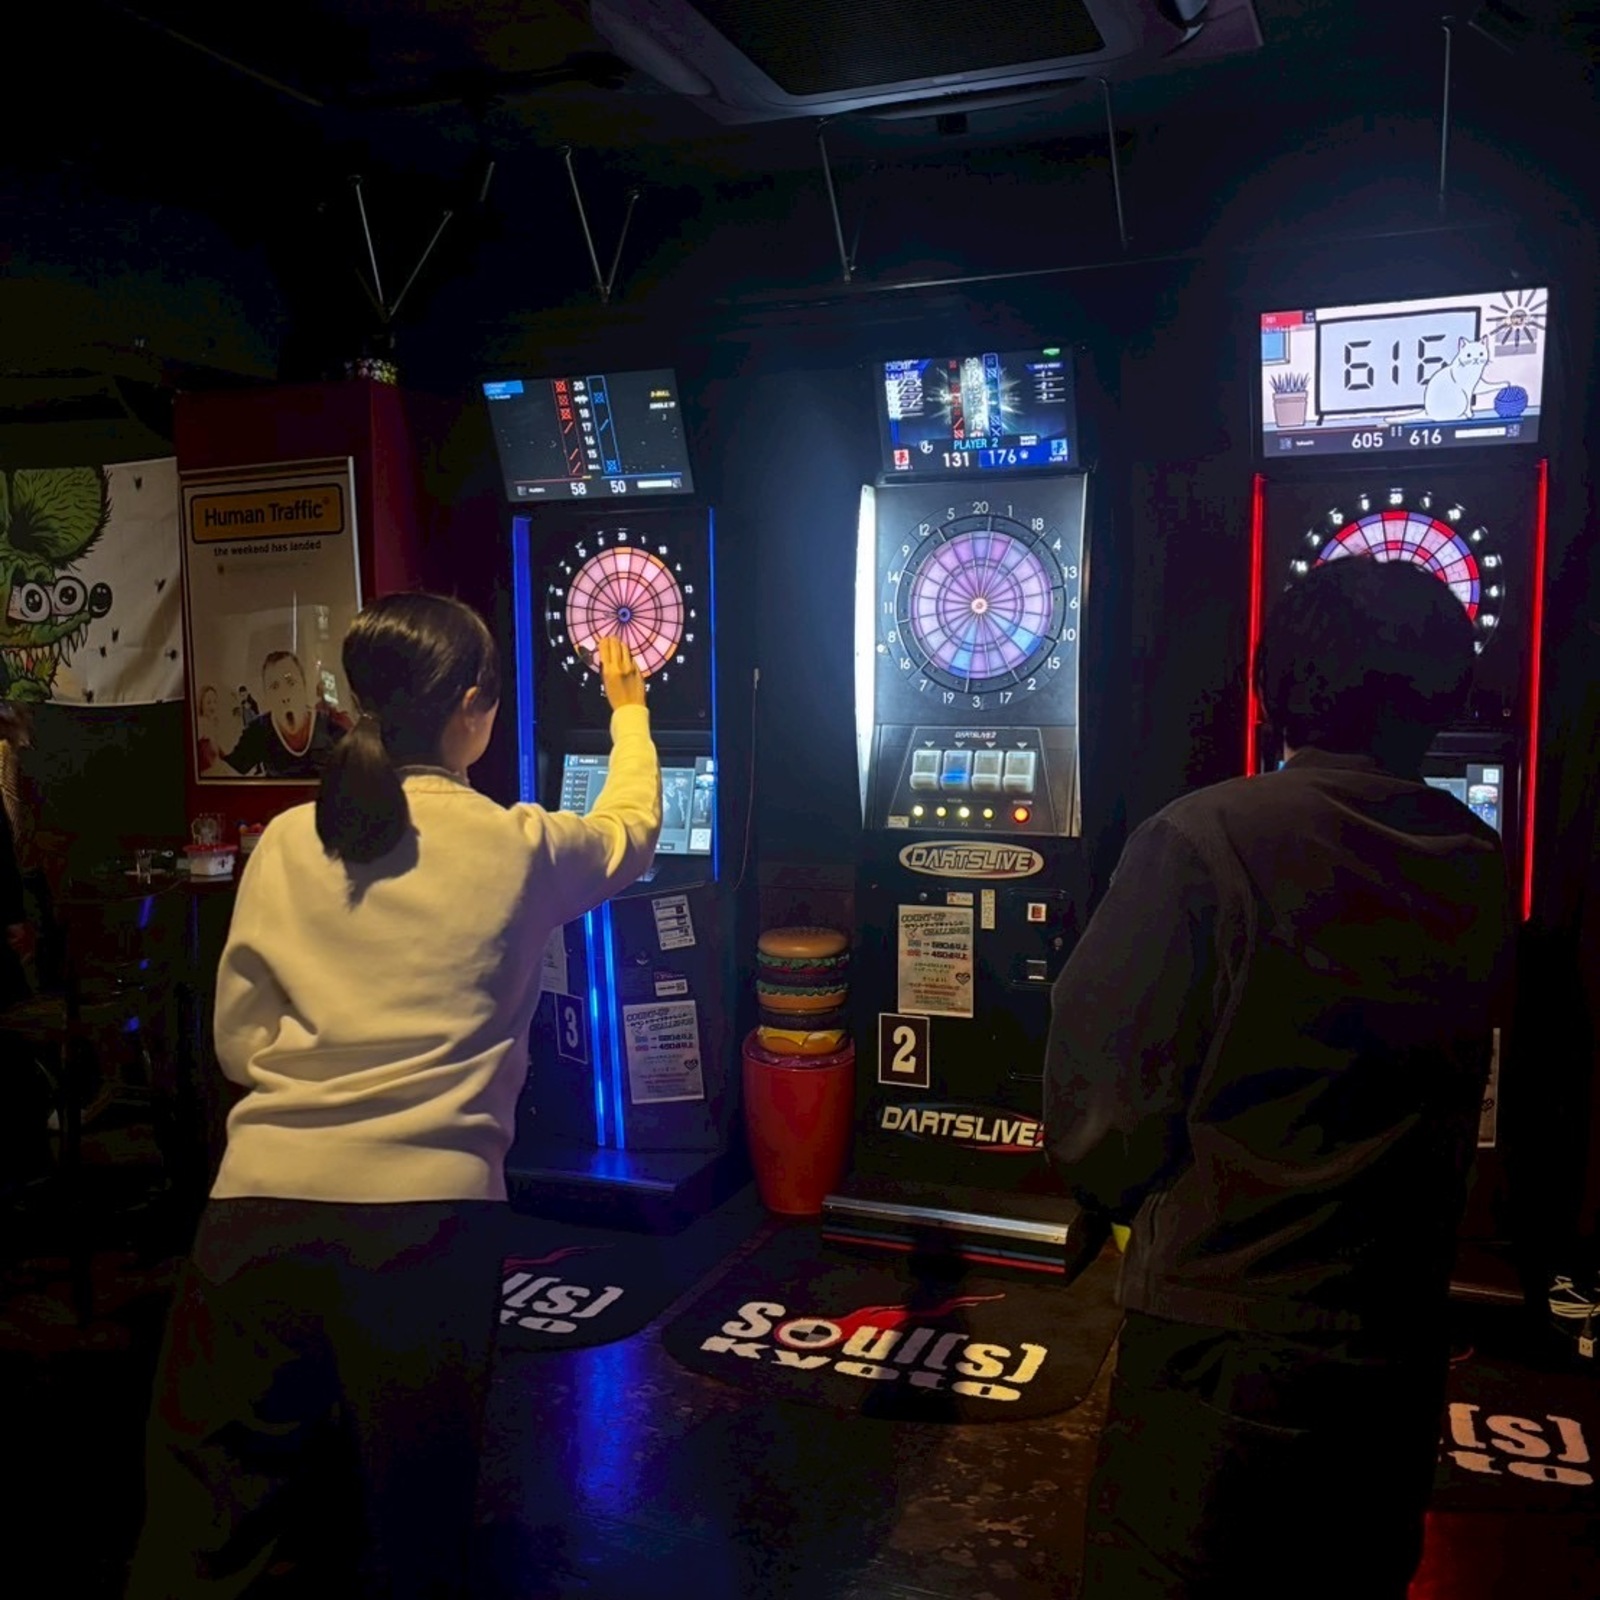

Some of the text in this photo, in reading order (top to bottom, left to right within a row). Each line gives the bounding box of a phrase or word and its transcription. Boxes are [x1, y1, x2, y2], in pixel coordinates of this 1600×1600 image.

[573, 380, 585, 391] 20
[582, 422, 592, 432] 17
[584, 436, 595, 445] 16
[1351, 432, 1384, 448] 605
[1409, 429, 1442, 446] 616
[954, 438, 999, 450] PLAYER 2
[587, 449, 597, 458] 15
[942, 452, 970, 467] 131
[988, 449, 1017, 464] 176
[570, 482, 587, 496] 58
[611, 480, 627, 494] 50
[1390, 493, 1402, 504] 20
[204, 499, 324, 527] Human Traffic
[973, 501, 989, 514] 20
[1007, 505, 1013, 516] 1
[947, 508, 955, 520] 5
[1332, 514, 1343, 525] 12
[919, 524, 930, 536] 12
[1032, 518, 1044, 531] 18
[618, 532, 627, 541] 20
[1473, 530, 1481, 541] 4
[214, 540, 321, 557] the weekend has landed
[902, 545, 910, 556] 9
[1053, 540, 1061, 551] 4
[1485, 556, 1497, 567] 13
[887, 572, 899, 583] 14
[1064, 567, 1078, 579] 13
[884, 602, 893, 613] 11
[1070, 598, 1078, 609] 6
[1482, 615, 1494, 626] 10
[888, 632, 896, 643] 8
[1062, 629, 1076, 641] 10
[900, 658, 911, 670] 16
[1047, 657, 1061, 669] 15
[663, 673, 668, 681] 2
[919, 680, 928, 691] 7
[1027, 679, 1036, 690] 2
[943, 692, 955, 704] 19
[972, 696, 981, 708] 3
[999, 692, 1013, 704] 17
[955, 731, 997, 740] DARTSLIVE2
[911, 848, 1034, 872] DARTSLIVE
[564, 1006, 579, 1048] 3
[892, 1026, 917, 1073] 2
